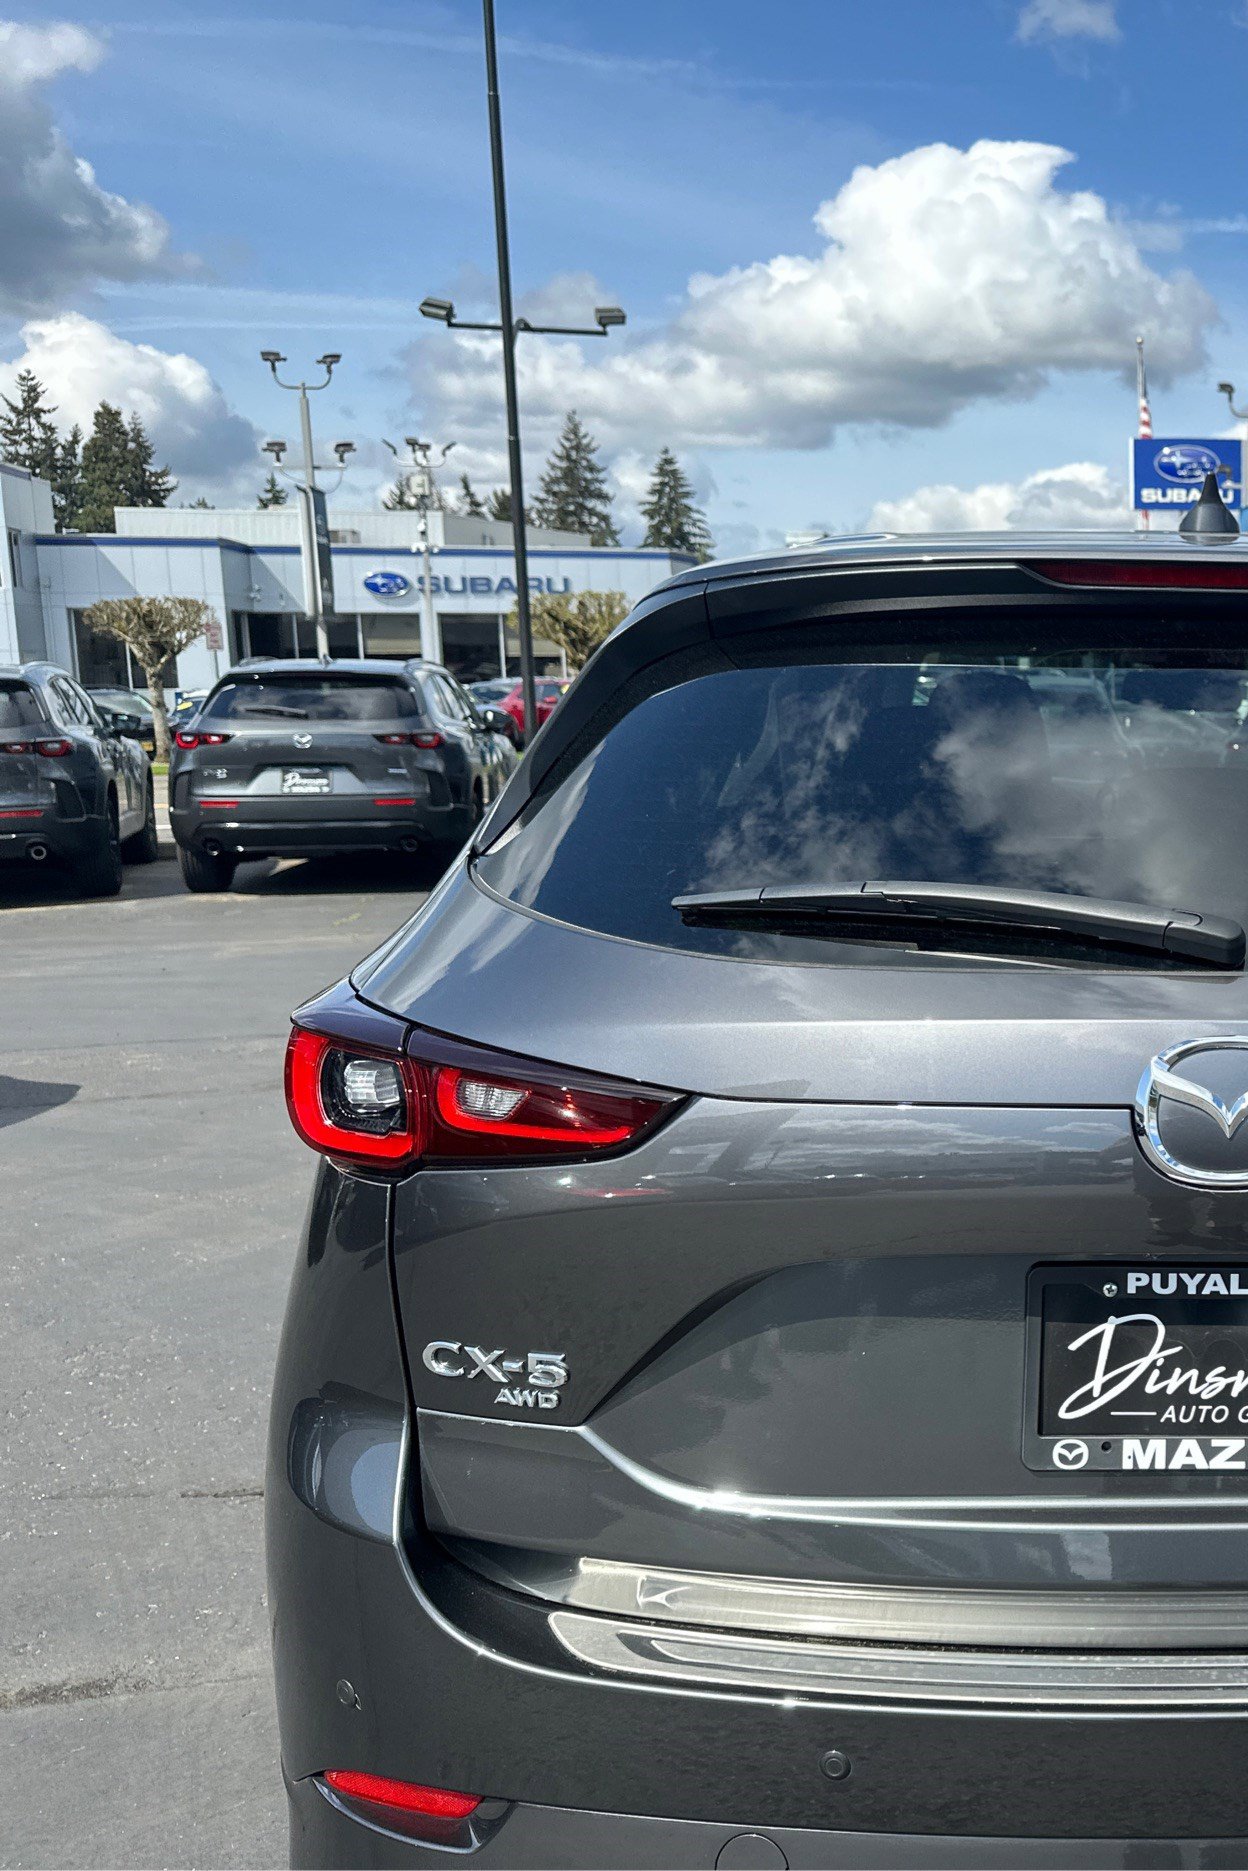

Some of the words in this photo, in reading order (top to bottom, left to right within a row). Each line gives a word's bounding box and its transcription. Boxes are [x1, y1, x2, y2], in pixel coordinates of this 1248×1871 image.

[1140, 487, 1234, 504] SUBAU
[417, 575, 570, 594] SUBARU
[422, 1340, 570, 1388] CX-5
[493, 1387, 561, 1410] AWD
[1159, 1404, 1230, 1424] AUTO
